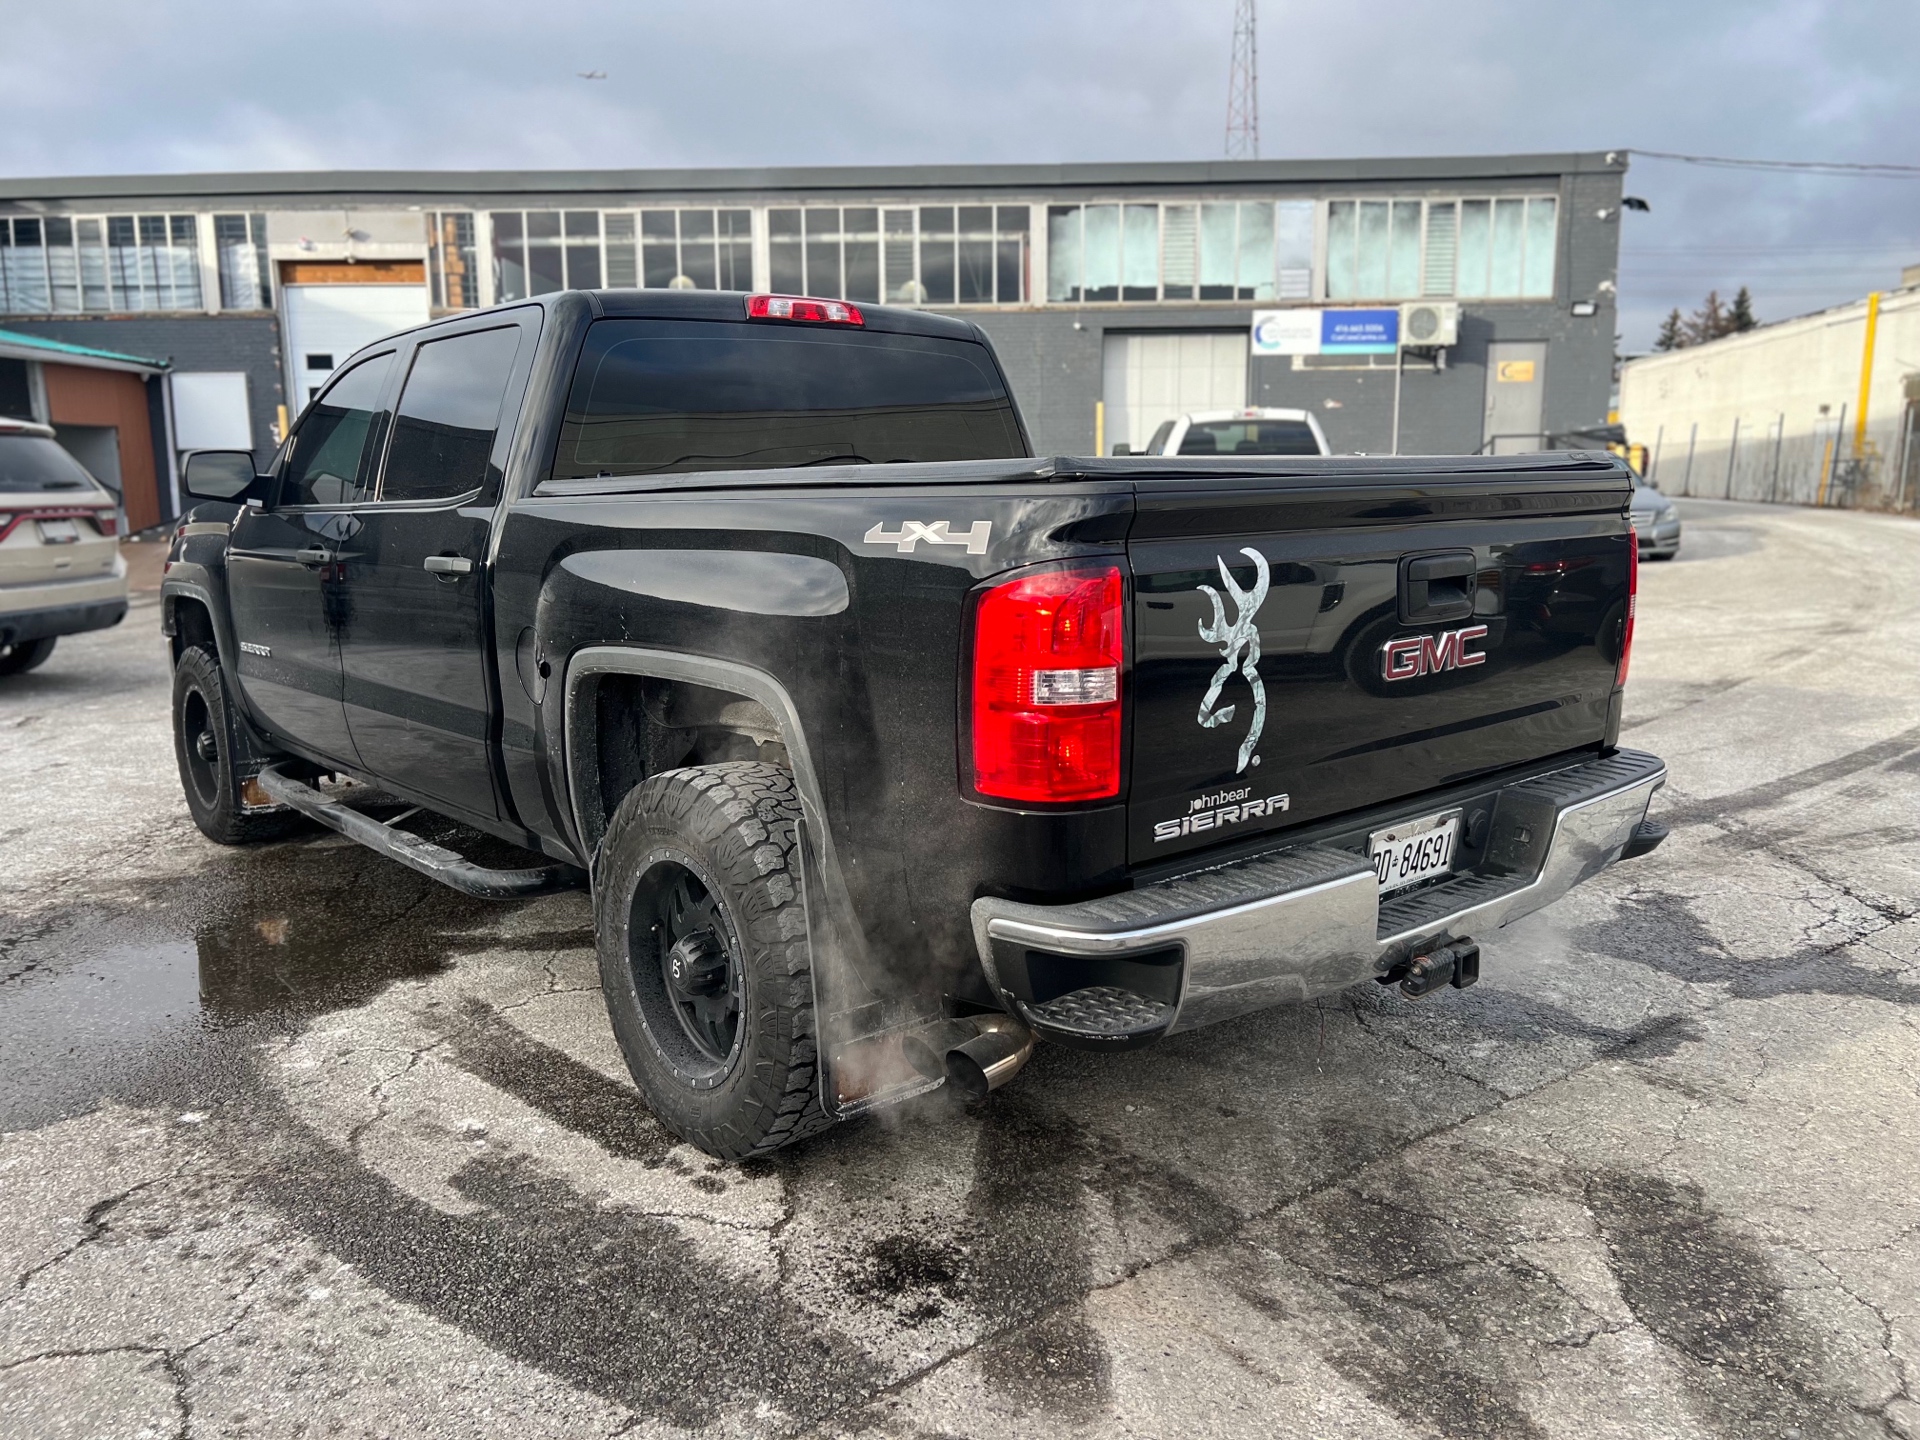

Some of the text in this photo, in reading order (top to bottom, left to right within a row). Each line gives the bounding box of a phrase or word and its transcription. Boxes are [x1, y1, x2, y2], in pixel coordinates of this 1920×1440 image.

[1383, 624, 1488, 682] GMC
[1153, 793, 1290, 842] SIERRA
[1188, 787, 1251, 814] johnbear
[1400, 832, 1452, 878] 84691
